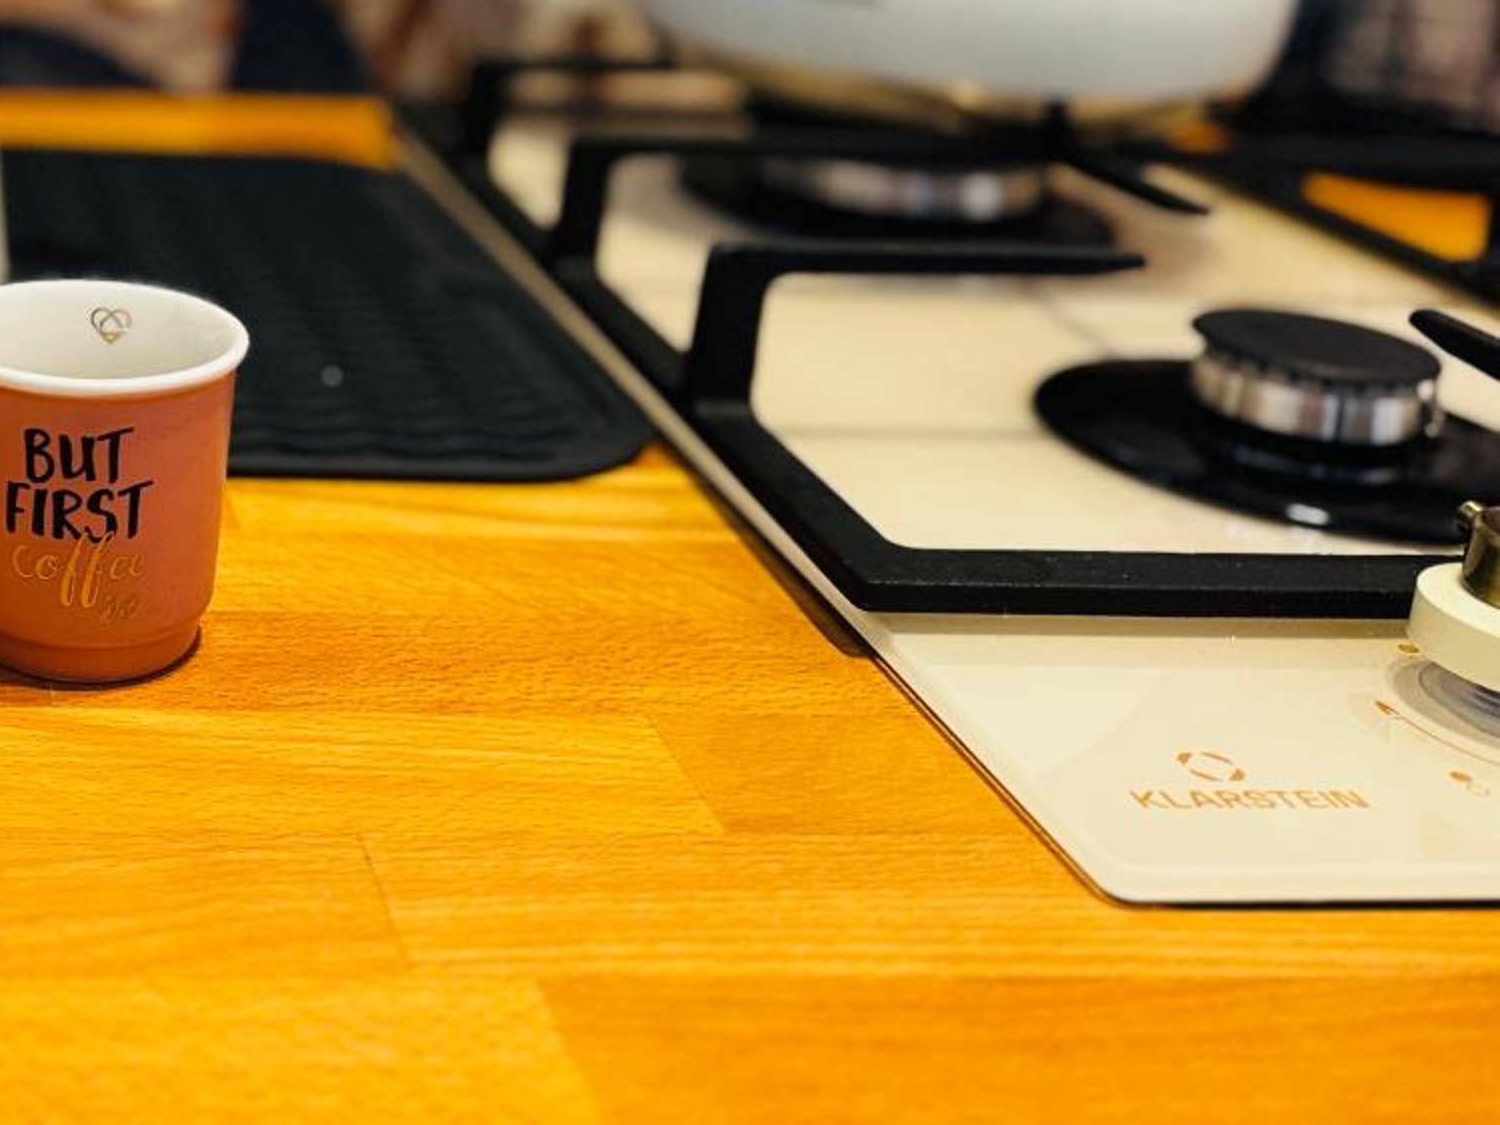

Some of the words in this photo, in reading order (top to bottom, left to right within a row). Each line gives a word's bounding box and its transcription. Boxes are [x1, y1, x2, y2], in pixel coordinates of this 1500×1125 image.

[23, 427, 135, 484] BUT
[4, 480, 154, 544] FIRST
[1130, 787, 1370, 810] KLARSTEIN
